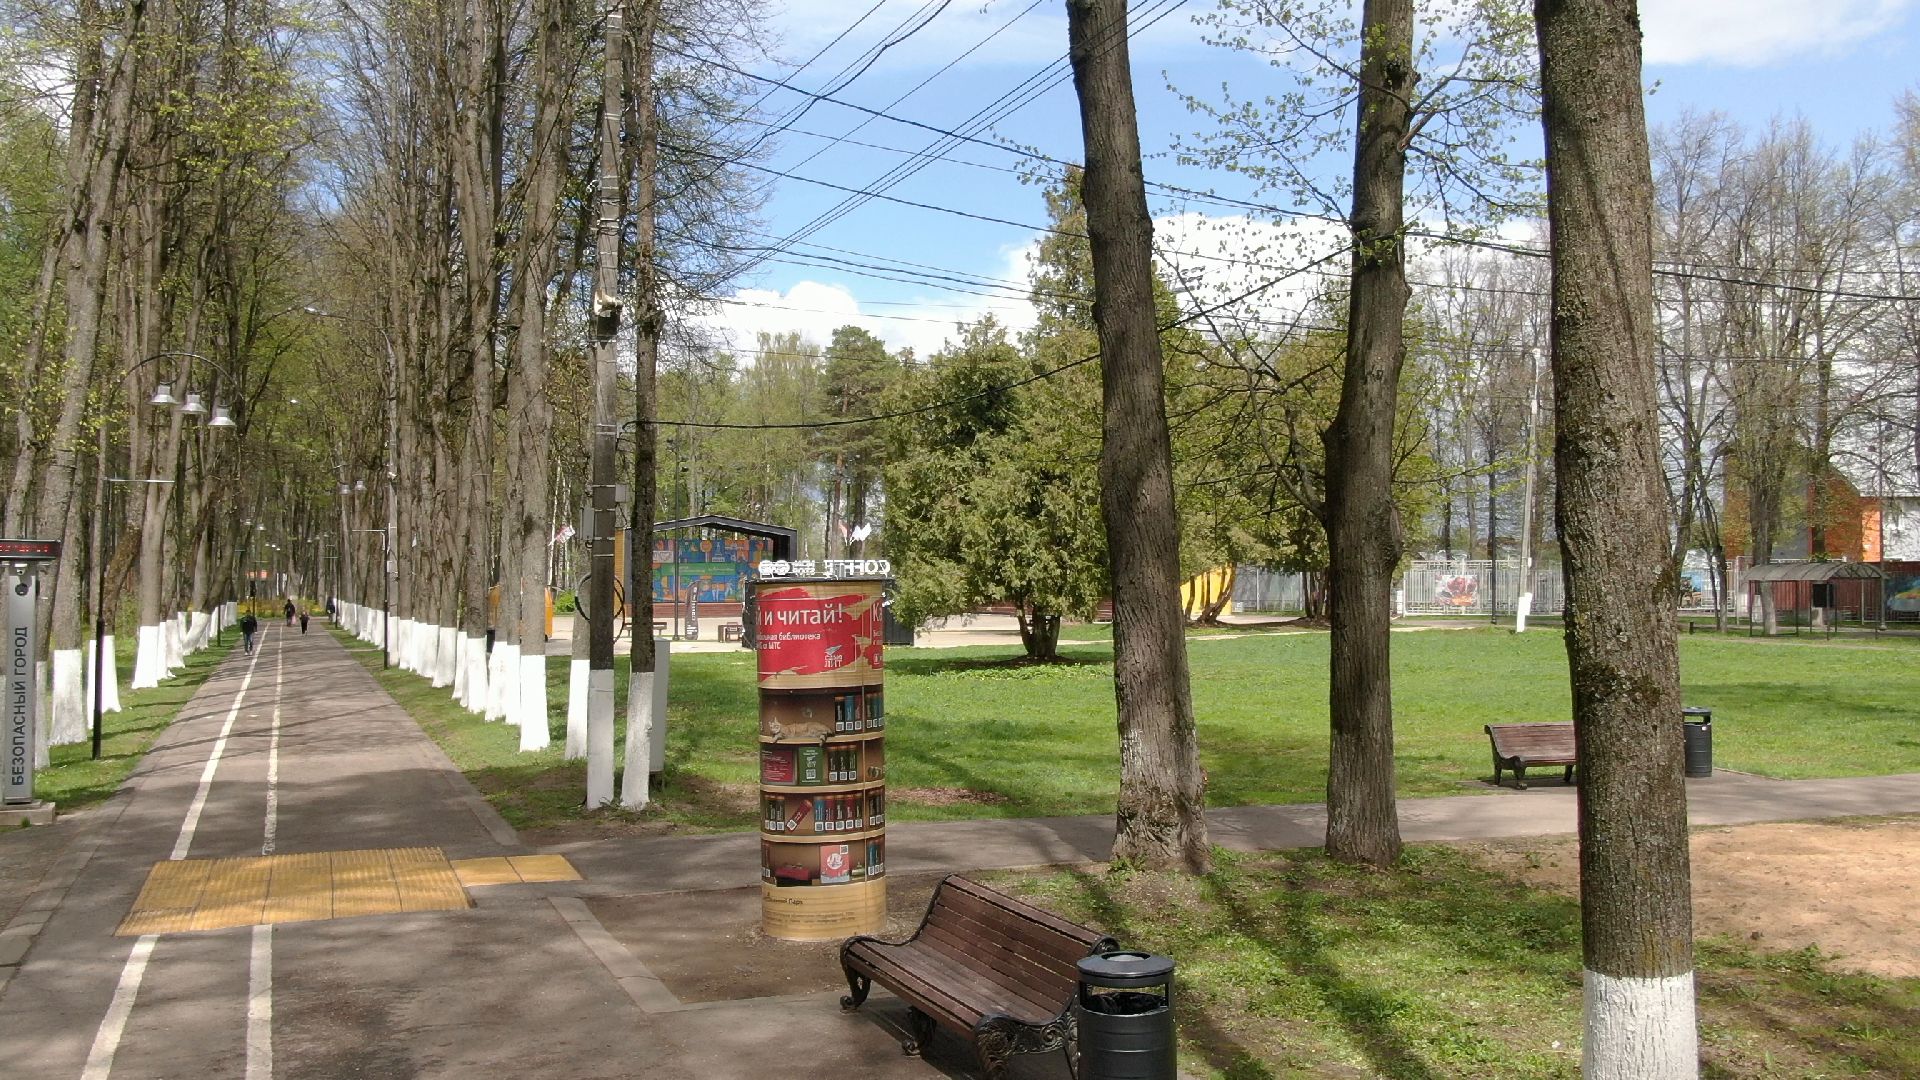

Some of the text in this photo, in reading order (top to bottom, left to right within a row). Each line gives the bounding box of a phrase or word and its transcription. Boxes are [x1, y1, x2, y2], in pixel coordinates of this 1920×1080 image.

[778, 603, 843, 625] читай!
[12, 626, 28, 786] БЕЗОПАСНЫЙ ГОРОД
